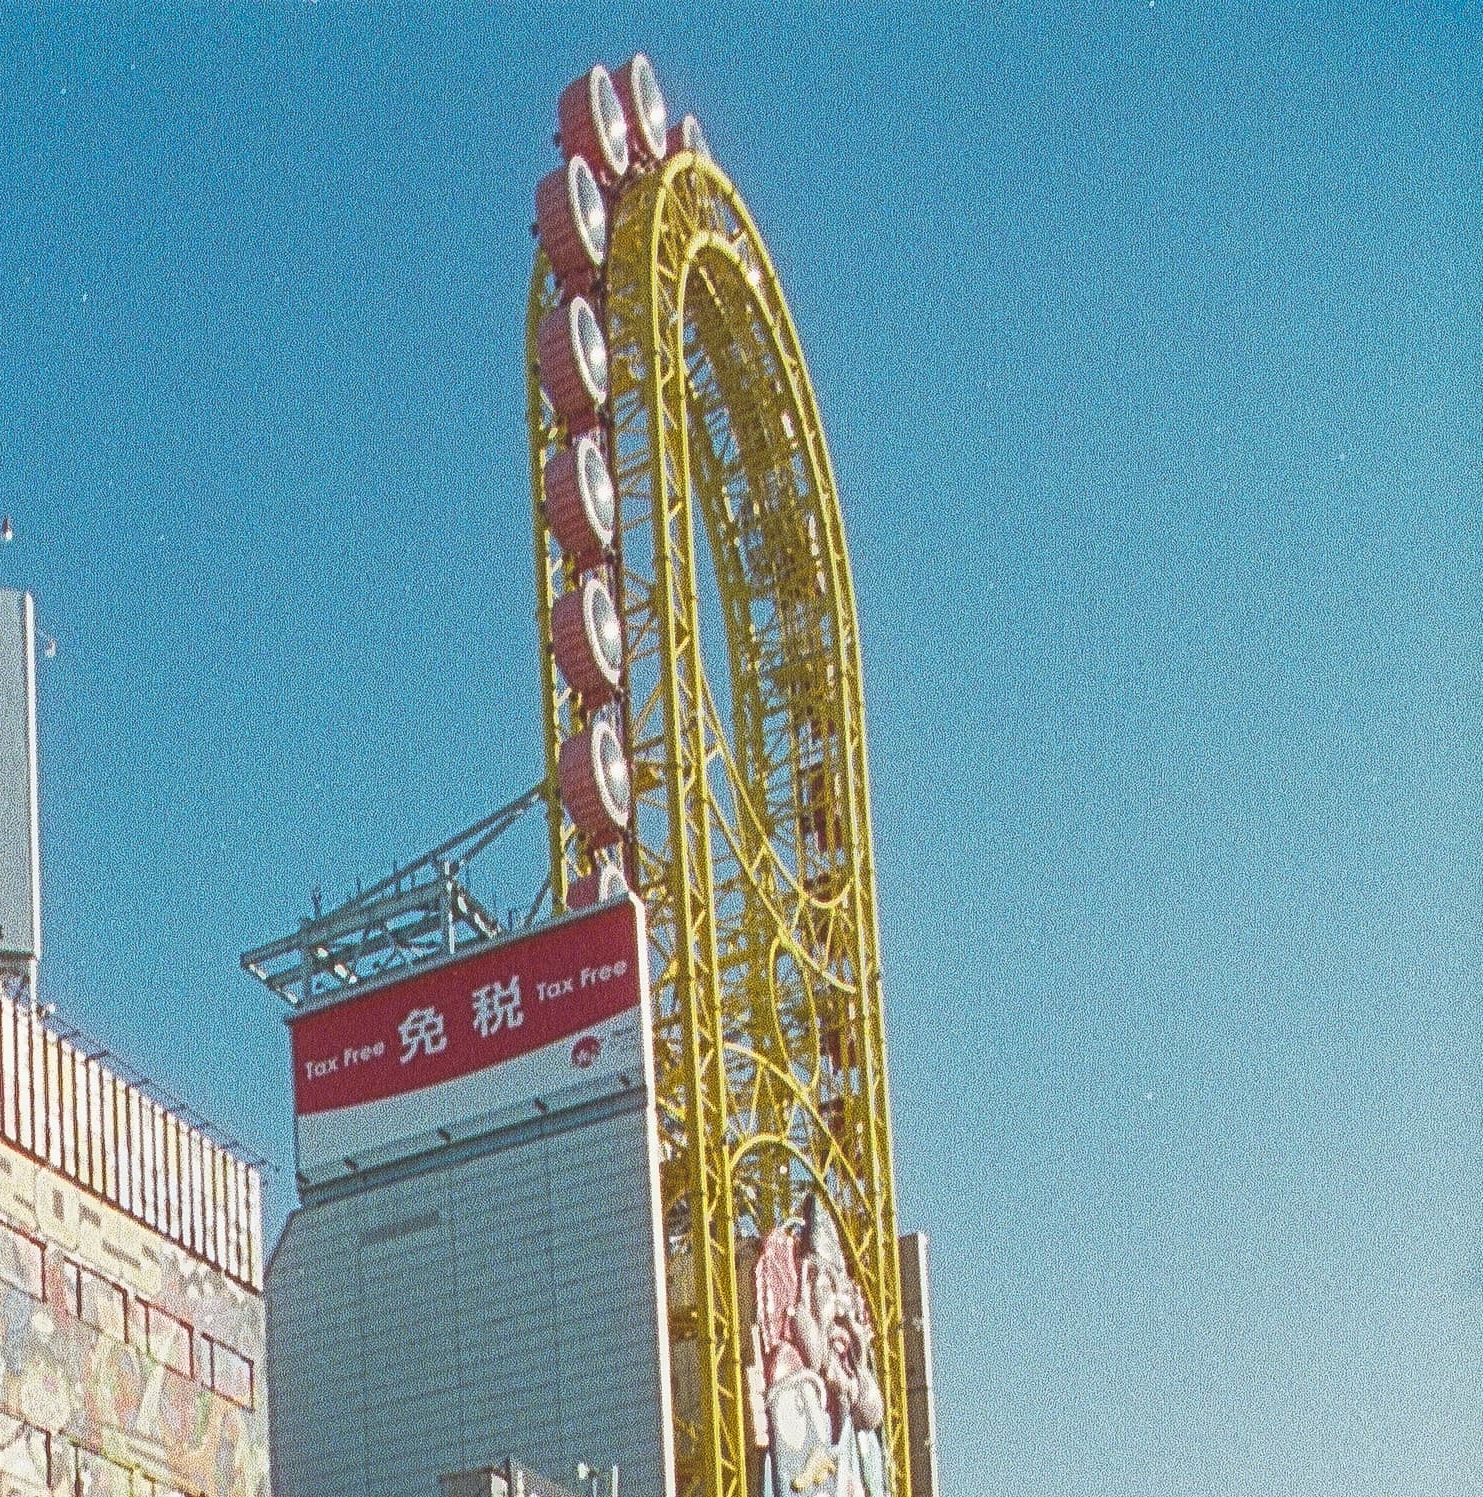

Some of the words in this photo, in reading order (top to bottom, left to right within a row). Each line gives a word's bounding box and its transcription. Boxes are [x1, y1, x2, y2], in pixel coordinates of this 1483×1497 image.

[305, 1060, 337, 1081] Tax
[344, 1041, 386, 1067] Free
[537, 981, 573, 1002] Tax
[581, 959, 628, 986] Free
